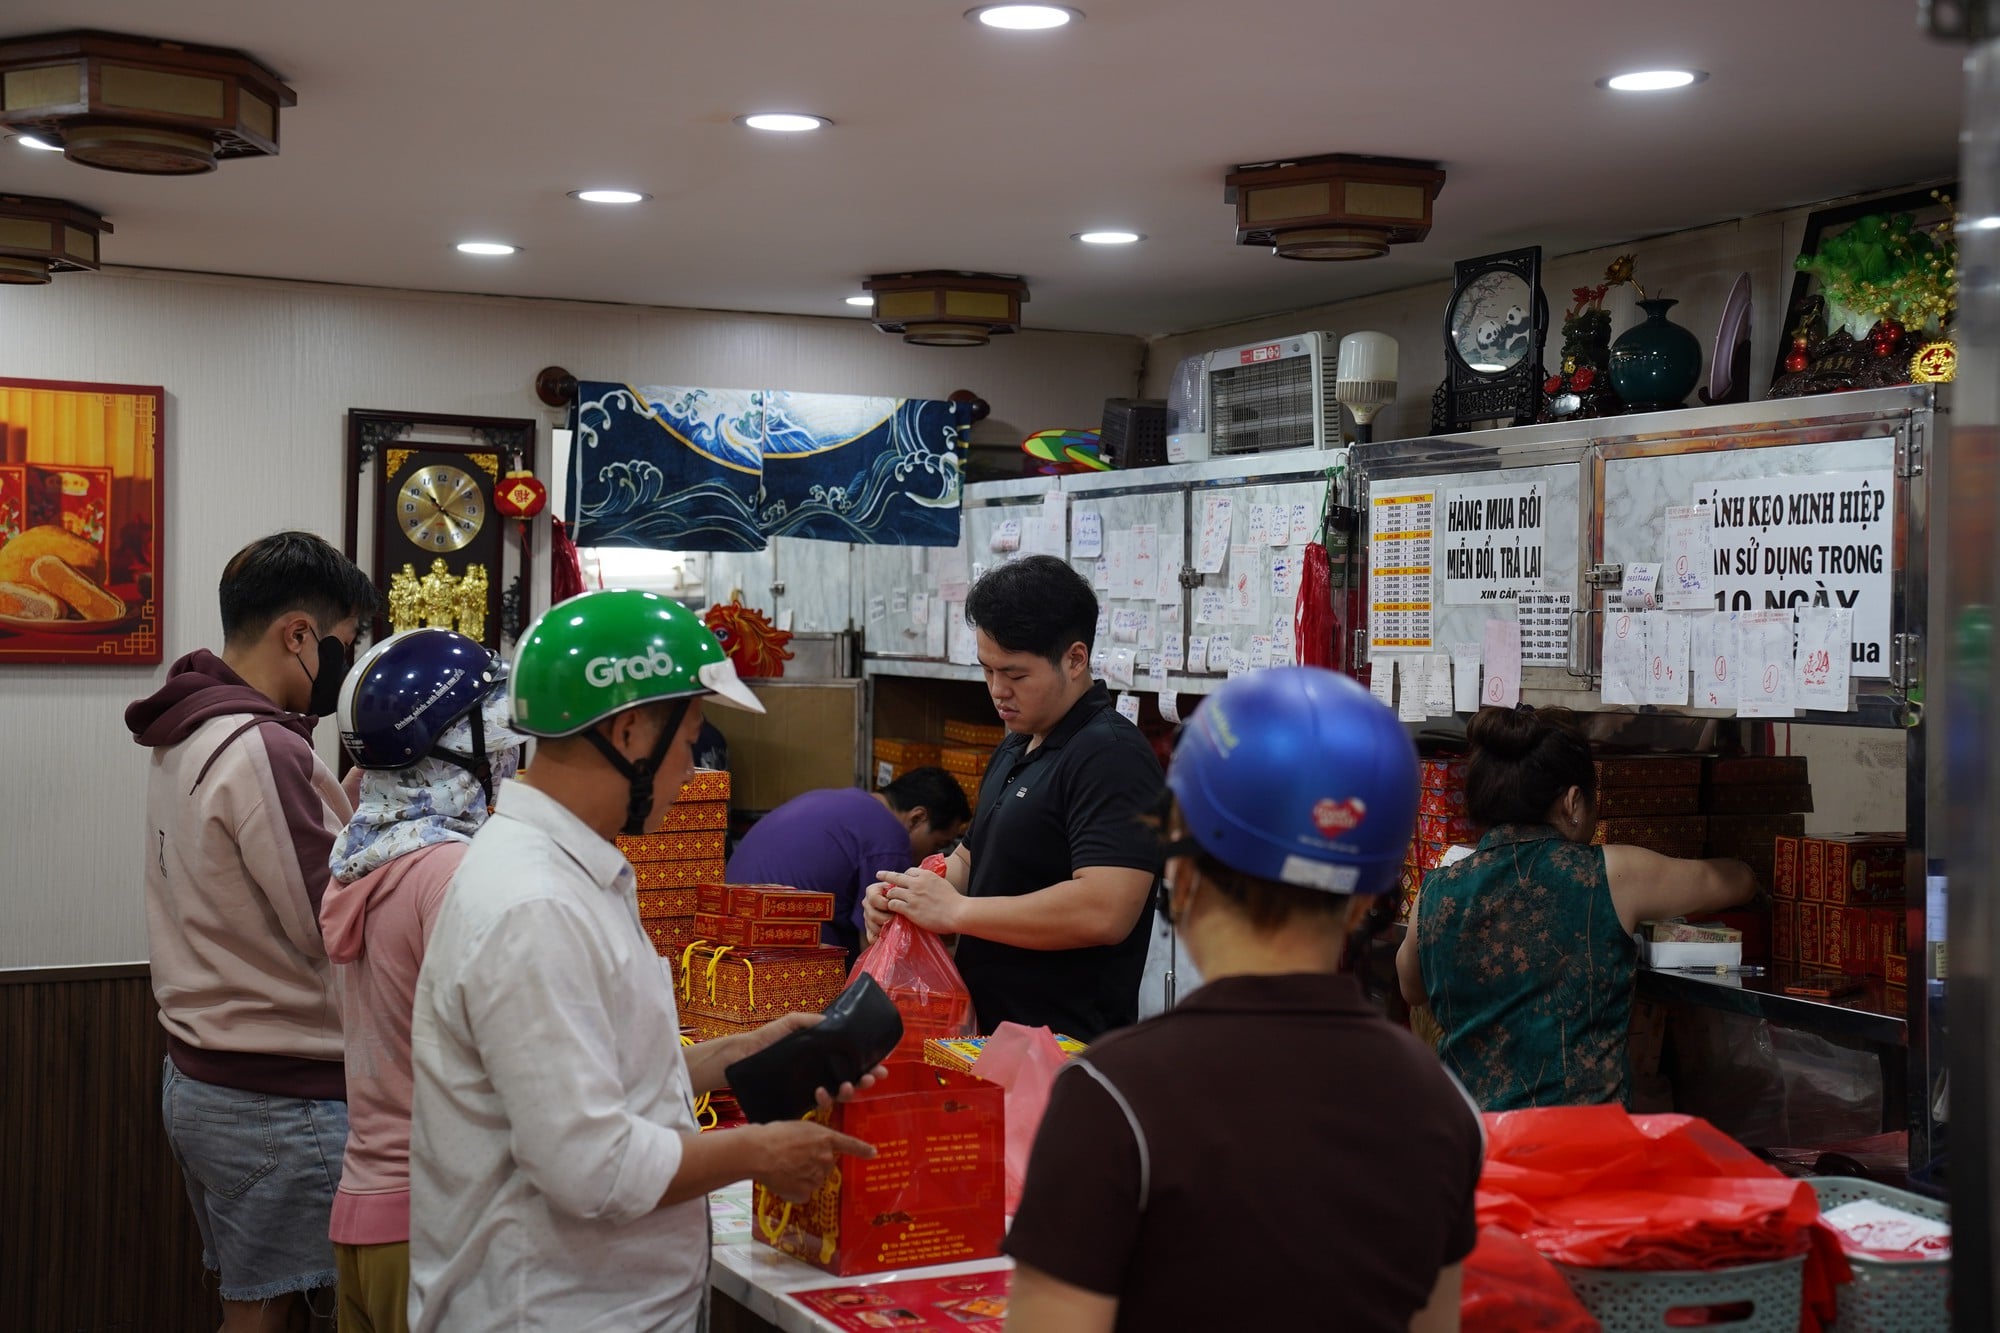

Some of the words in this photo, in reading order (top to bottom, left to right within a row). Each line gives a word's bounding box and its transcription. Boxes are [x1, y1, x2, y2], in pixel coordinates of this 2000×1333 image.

[410, 519, 418, 527] 8
[1448, 494, 1482, 532] HÀNG
[1486, 498, 1514, 530] MUA
[1699, 489, 1744, 528] ÁNH
[1749, 495, 1784, 533] KẸO
[1788, 492, 1834, 525] MINH
[1839, 480, 1885, 530] HIỆP
[1447, 537, 1473, 579] MIỄN
[1500, 536, 1520, 578] TRẢ
[1524, 546, 1541, 585] LẠI
[1736, 537, 1759, 575] SỬ
[1765, 546, 1812, 580] DỤNG
[1819, 544, 1882, 574] TRONG
[1480, 591, 1497, 599] XIN
[1714, 590, 1751, 612] 10
[585, 646, 673, 688] Grab
